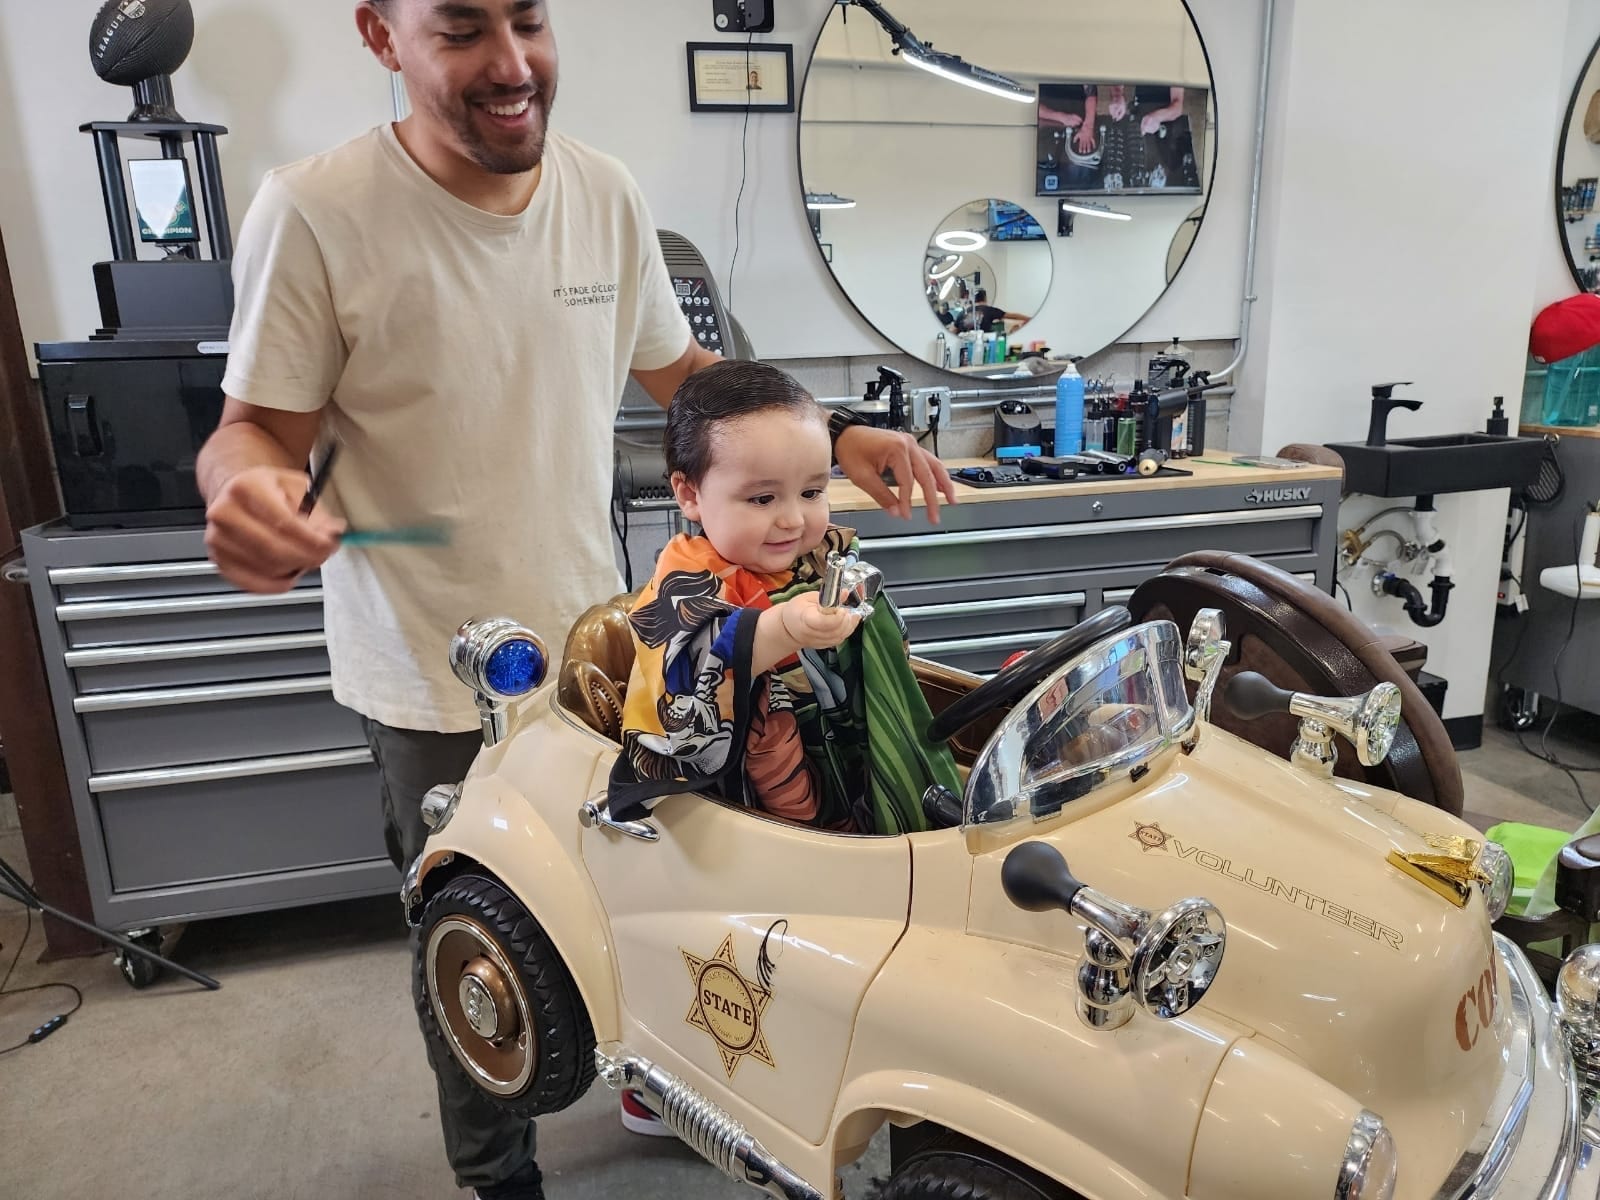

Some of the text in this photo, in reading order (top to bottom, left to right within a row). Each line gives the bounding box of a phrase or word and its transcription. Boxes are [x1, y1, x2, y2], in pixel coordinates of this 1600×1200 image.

[96, 14, 126, 59] LEAGUE
[141, 226, 193, 236] CHPION
[553, 281, 618, 298] IT'S FADE O'CLOC
[564, 294, 616, 307] SOMEWHERE
[1263, 486, 1312, 502] HUSKY
[1173, 839, 1404, 950] VOLUNTEER
[703, 989, 752, 1027] STATE
[1455, 943, 1497, 1052] CO
